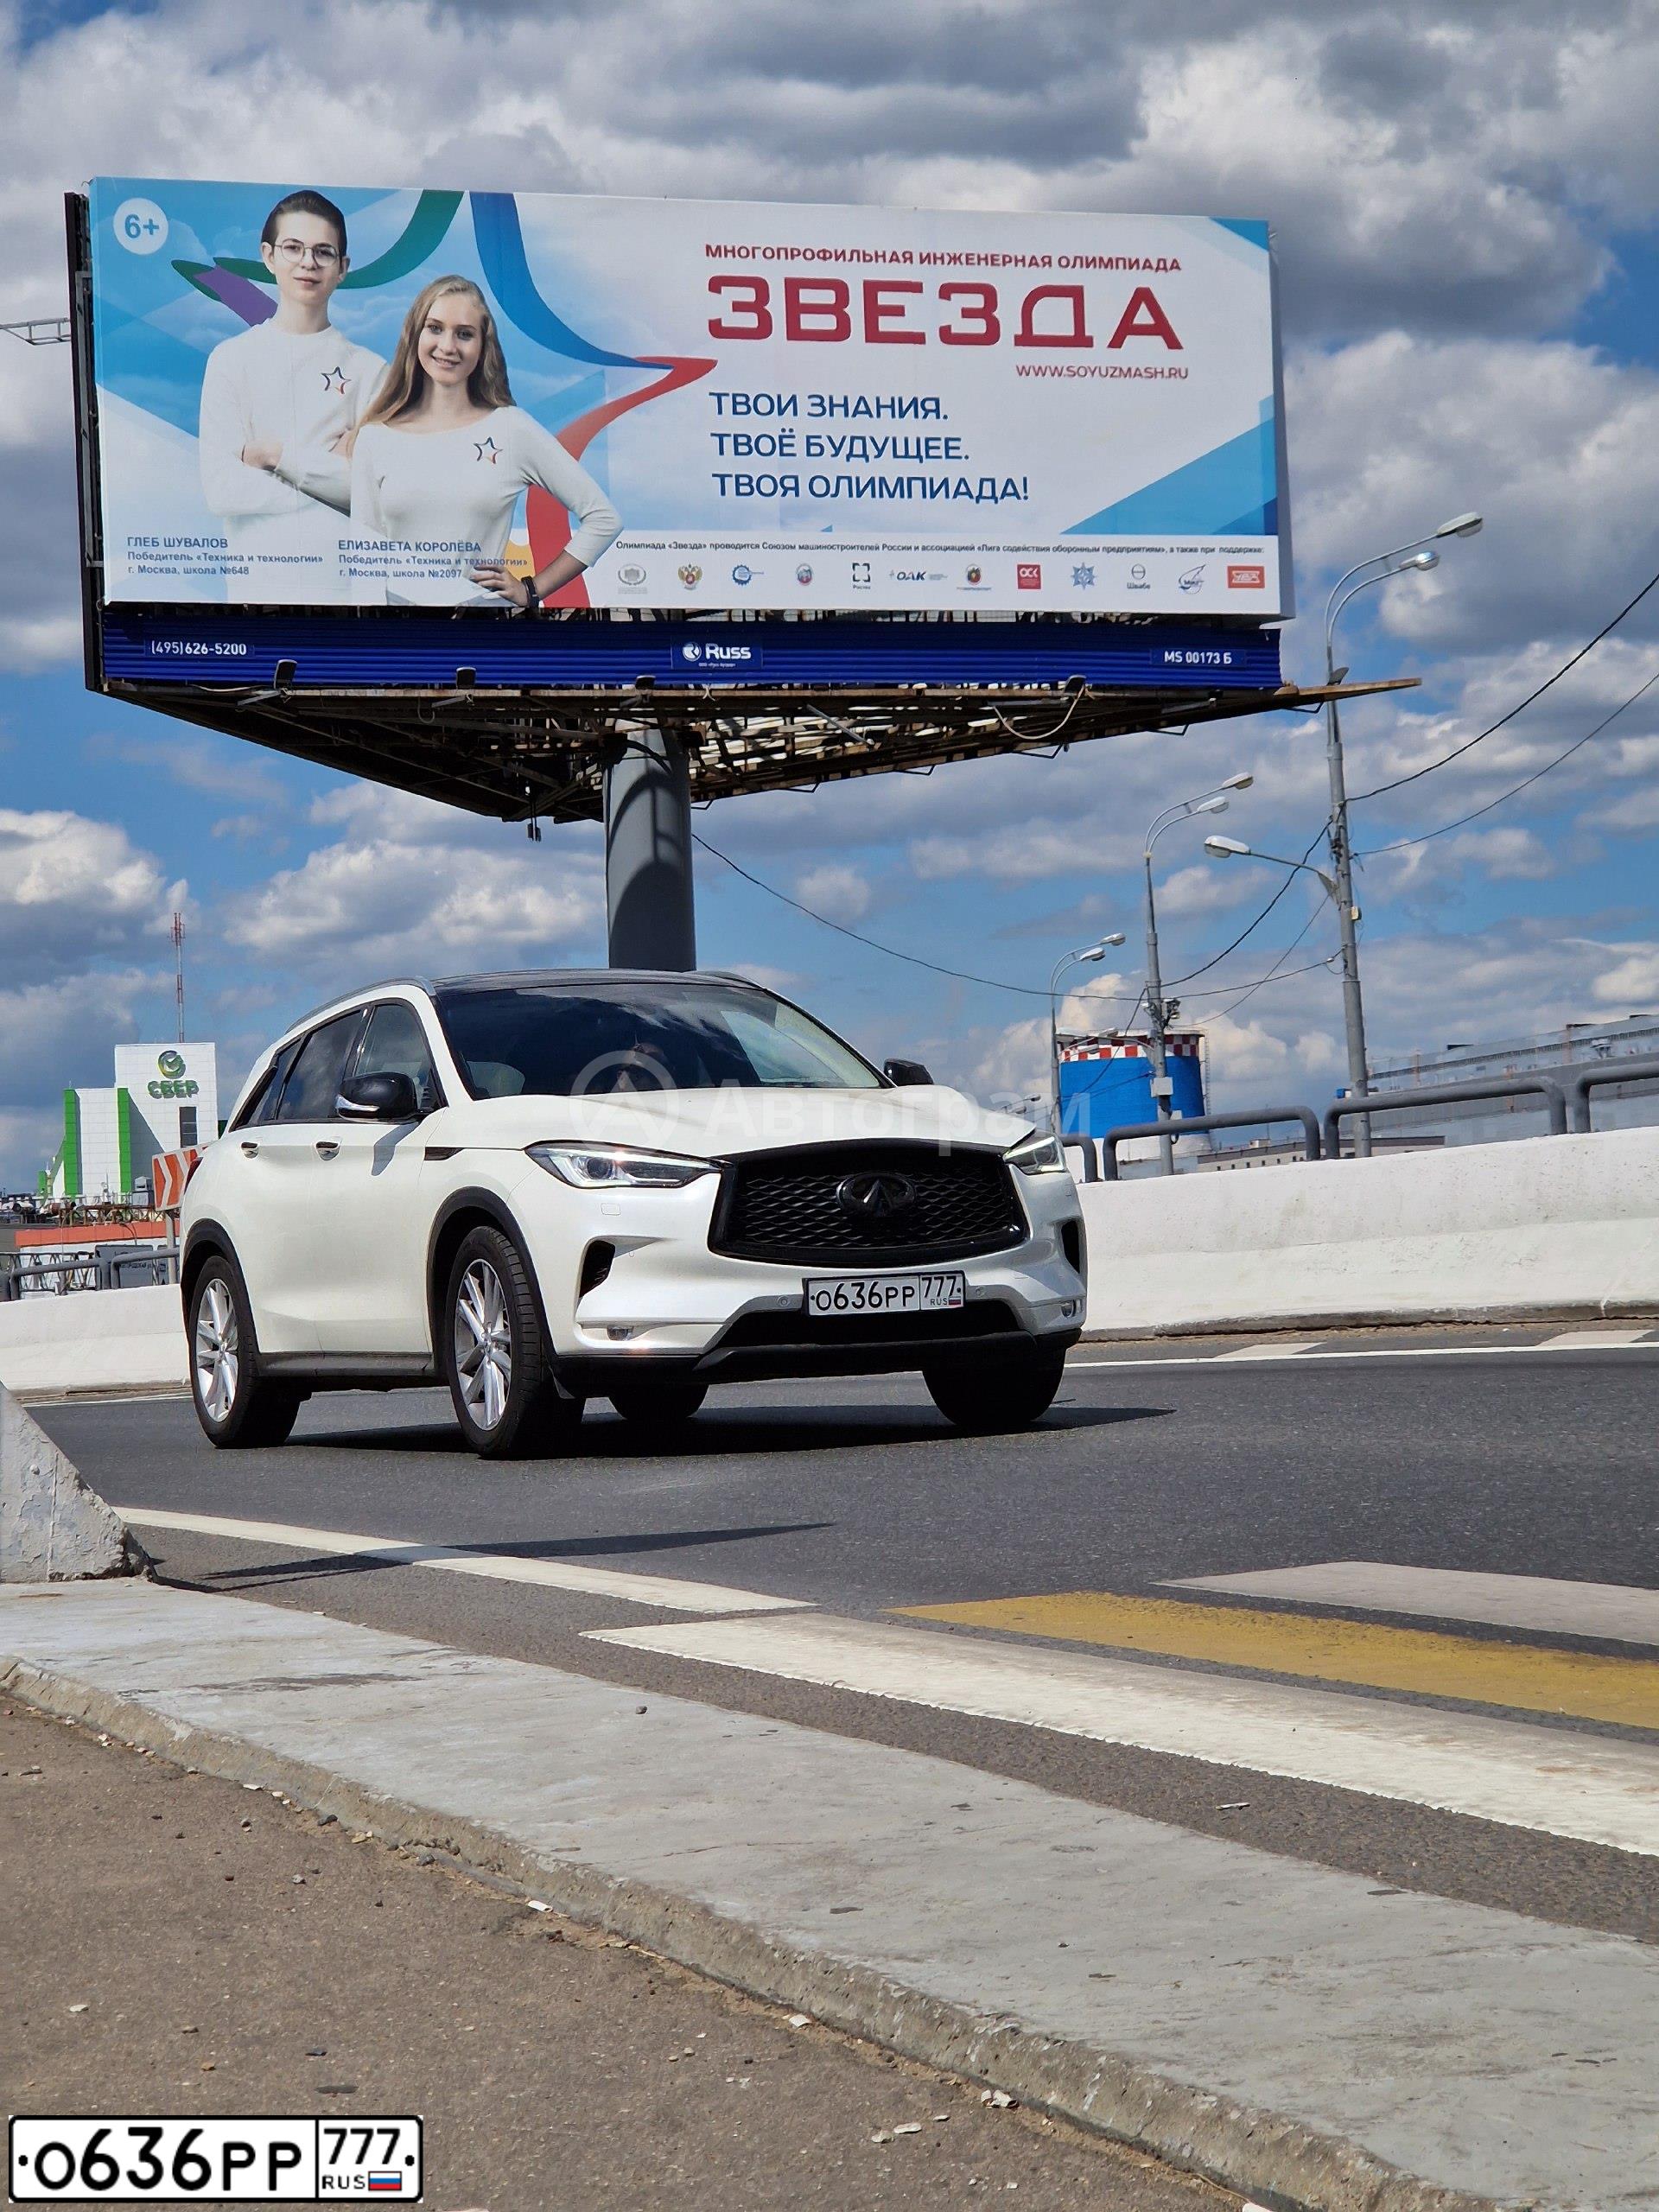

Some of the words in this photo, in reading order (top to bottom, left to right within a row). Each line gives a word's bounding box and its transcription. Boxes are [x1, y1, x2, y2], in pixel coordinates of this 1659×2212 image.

[124, 213, 160, 238] 6+
[704, 244, 914, 265] МНОГОПРОФИЛЬНАЯ
[918, 251, 1052, 269] ИНЖЕНЕРНАЯ
[1057, 255, 1182, 273] ОЛИМПИАДА
[707, 274, 1184, 350] ЗВЕЗДА
[1015, 364, 1189, 380] WWW.SOYUZMASH.RU
[709, 391, 798, 418] ТВОИ
[806, 394, 949, 421] ЗНАНИЯ.
[710, 428, 798, 458] ТВОЁ
[804, 434, 970, 463] БУДУЩЕЕ.
[711, 472, 800, 499] ТВОЯ
[807, 474, 1029, 505] ОЛИМПИАДА!
[127, 537, 160, 548] ГЛЕБ
[163, 537, 228, 549] ШУВАЛОВ
[338, 540, 412, 551] ЕЛИЗАВЕТА
[415, 539, 482, 552] КОРОЛЁВА
[616, 541, 666, 550] Олимпиада
[668, 542, 707, 550] «Звезда»
[709, 543, 760, 551] проводится
[762, 542, 796, 551] Союзом
[798, 543, 880, 553] машиностроителей
[881, 543, 912, 552] России
[921, 543, 975, 553] ассоциацией
[1002, 544, 1050, 553] содействия
[1052, 544, 1100, 554] оборонным
[127, 551, 194, 563] Победитель
[196, 552, 245, 563] «Техника
[257, 555, 323, 564] технологии»
[339, 554, 403, 565] Победитель
[406, 556, 452, 565] «Техника
[137, 565, 181, 575] Москва,
[183, 567, 217, 575] школа
[219, 566, 250, 575] №648
[348, 568, 390, 578] Москва,
[393, 569, 425, 578] школа
[428, 569, 462, 578] №2097
[150, 639, 248, 656] (495)626-5200
[705, 642, 752, 660] Russ
[1164, 650, 1183, 663] MS
[1185, 651, 1221, 664] 00173
[147, 1079, 200, 1100] СБЕР
[921, 1274, 957, 1299] 777
[930, 1297, 948, 1306] RUS
